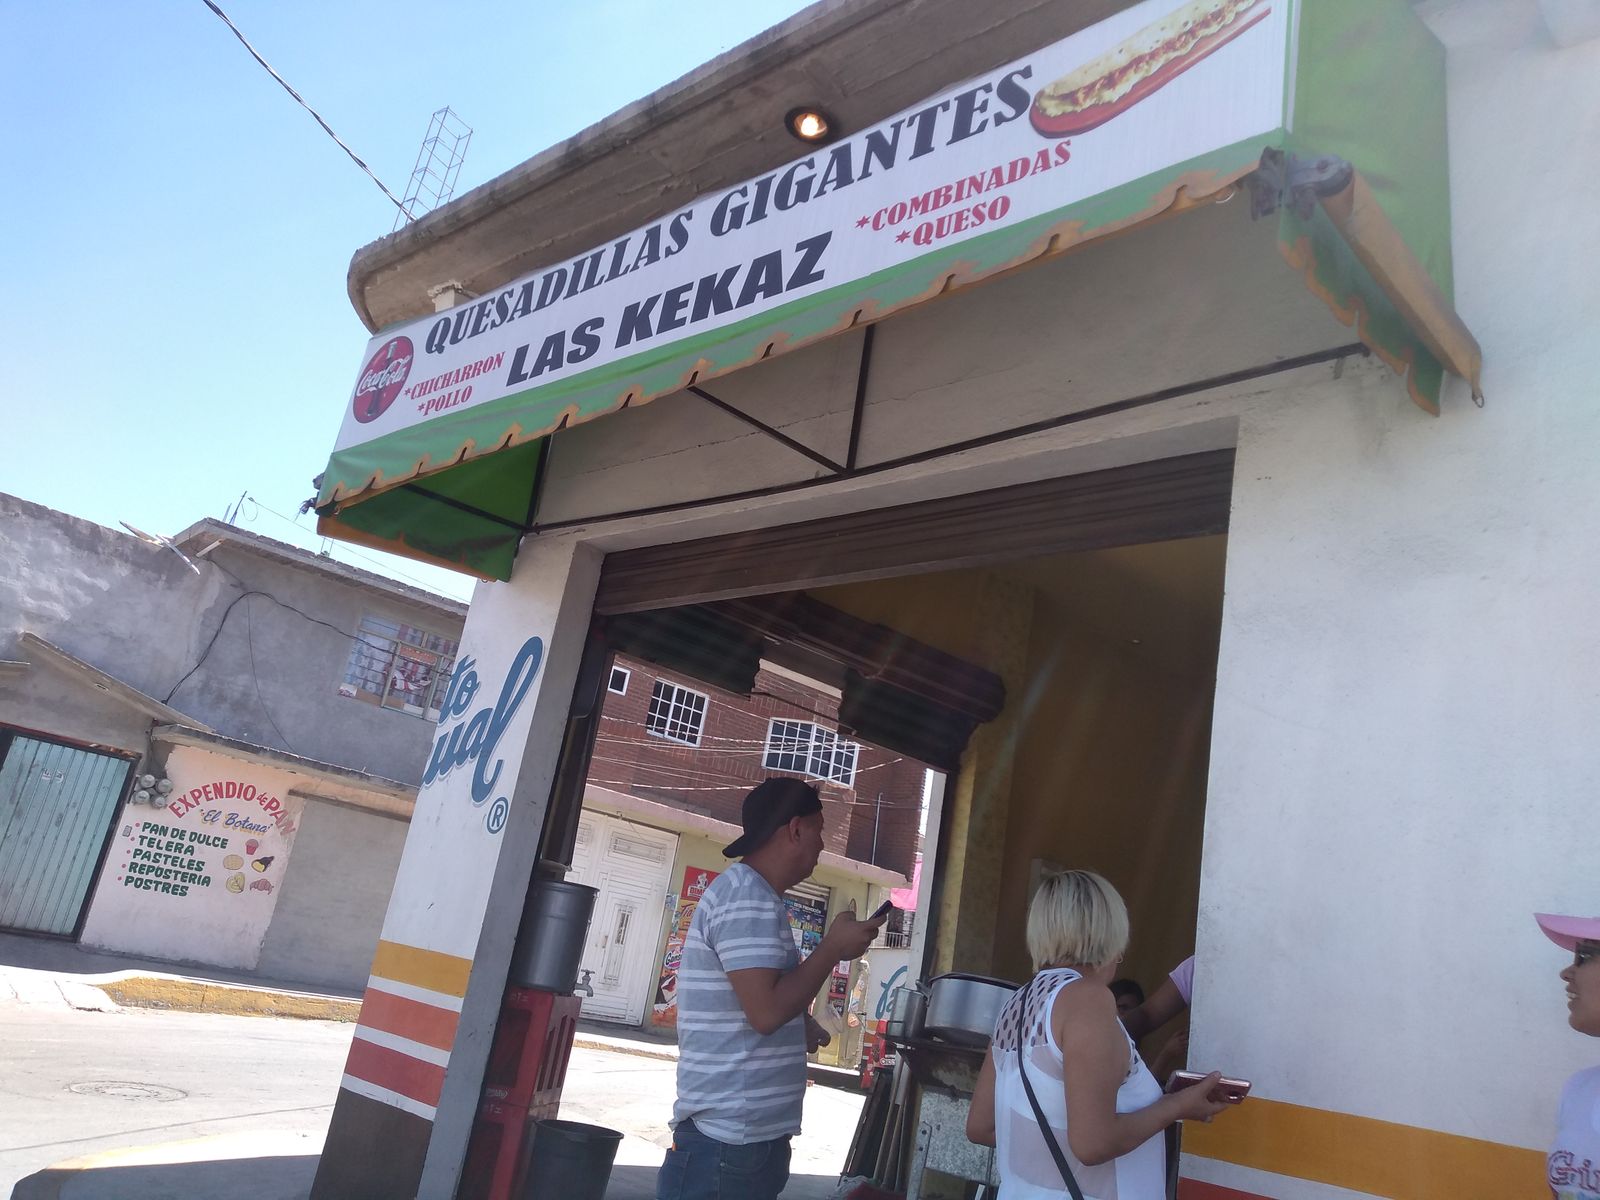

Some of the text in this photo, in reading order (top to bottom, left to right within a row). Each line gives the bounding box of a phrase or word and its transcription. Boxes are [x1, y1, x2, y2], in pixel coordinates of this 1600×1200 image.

[425, 64, 1035, 355] QUESADILLAS GIGANTES
[505, 230, 834, 388] LAS KEKAZ
[168, 781, 257, 819] EXPENDIO
[256, 791, 268, 807] de
[138, 834, 196, 857] TELERA
[141, 821, 230, 850] PAN DE DULCE
[132, 848, 206, 872] PASTELES
[123, 875, 190, 898] POSTRES
[127, 861, 212, 888] REPOSTERIA
[689, 886, 705, 897] BIM
